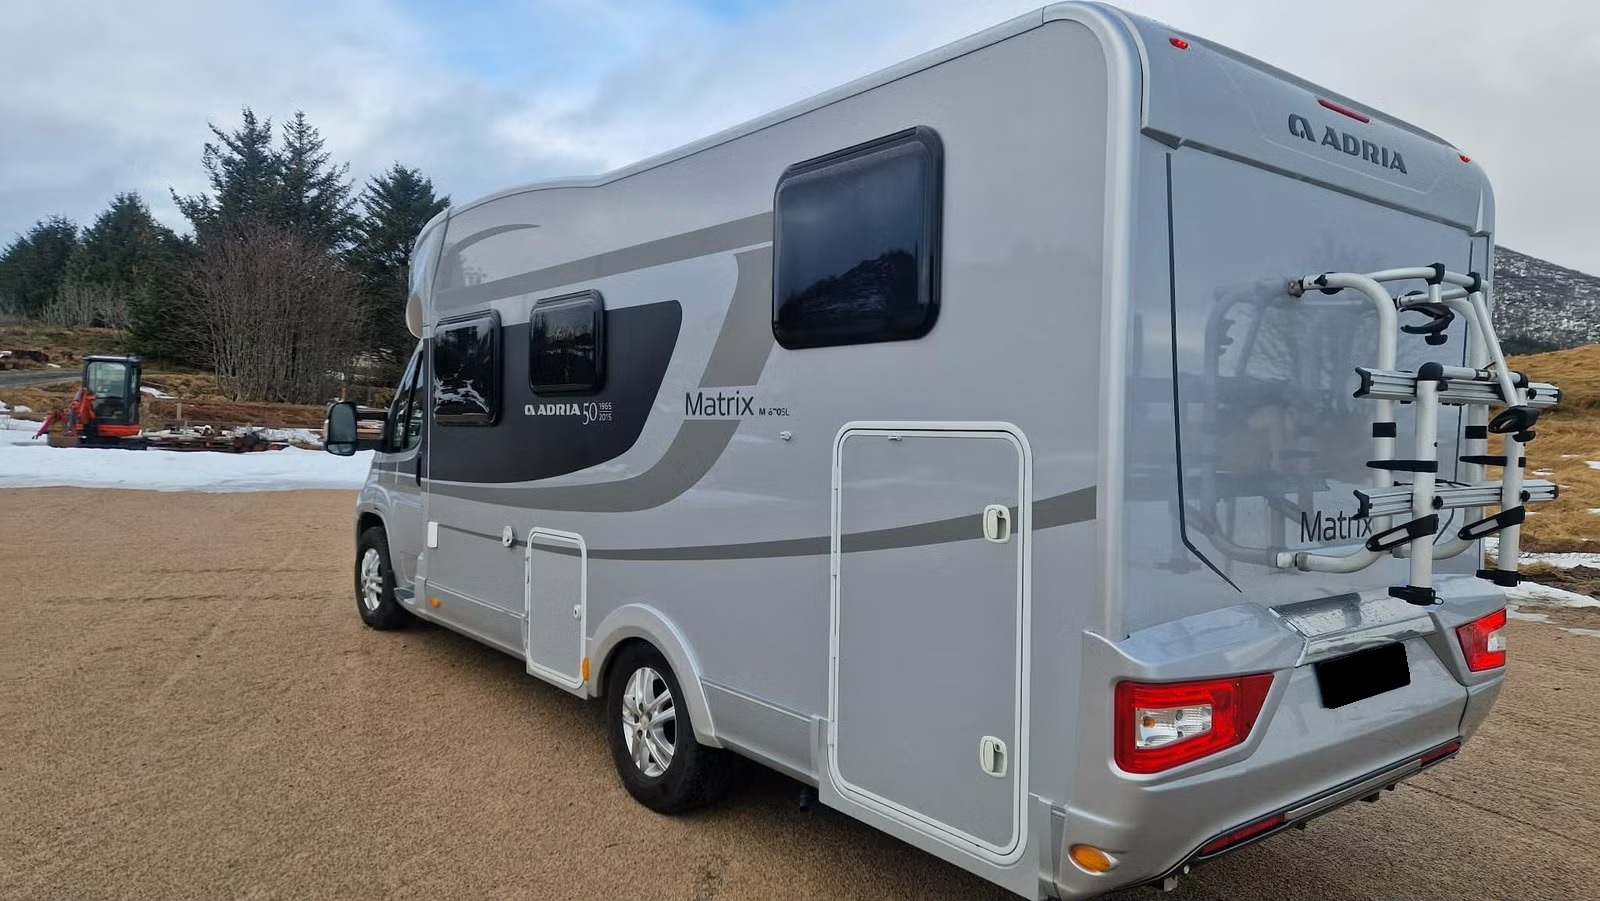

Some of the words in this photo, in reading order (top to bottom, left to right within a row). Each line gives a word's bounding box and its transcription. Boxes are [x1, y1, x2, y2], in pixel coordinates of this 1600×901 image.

[1321, 126, 1408, 174] ADRIA
[537, 403, 581, 416] ADRIA
[582, 401, 598, 425] 50
[598, 402, 612, 410] 1965
[685, 391, 754, 417] Matrix
[759, 407, 766, 416] M
[598, 413, 612, 421] 2015
